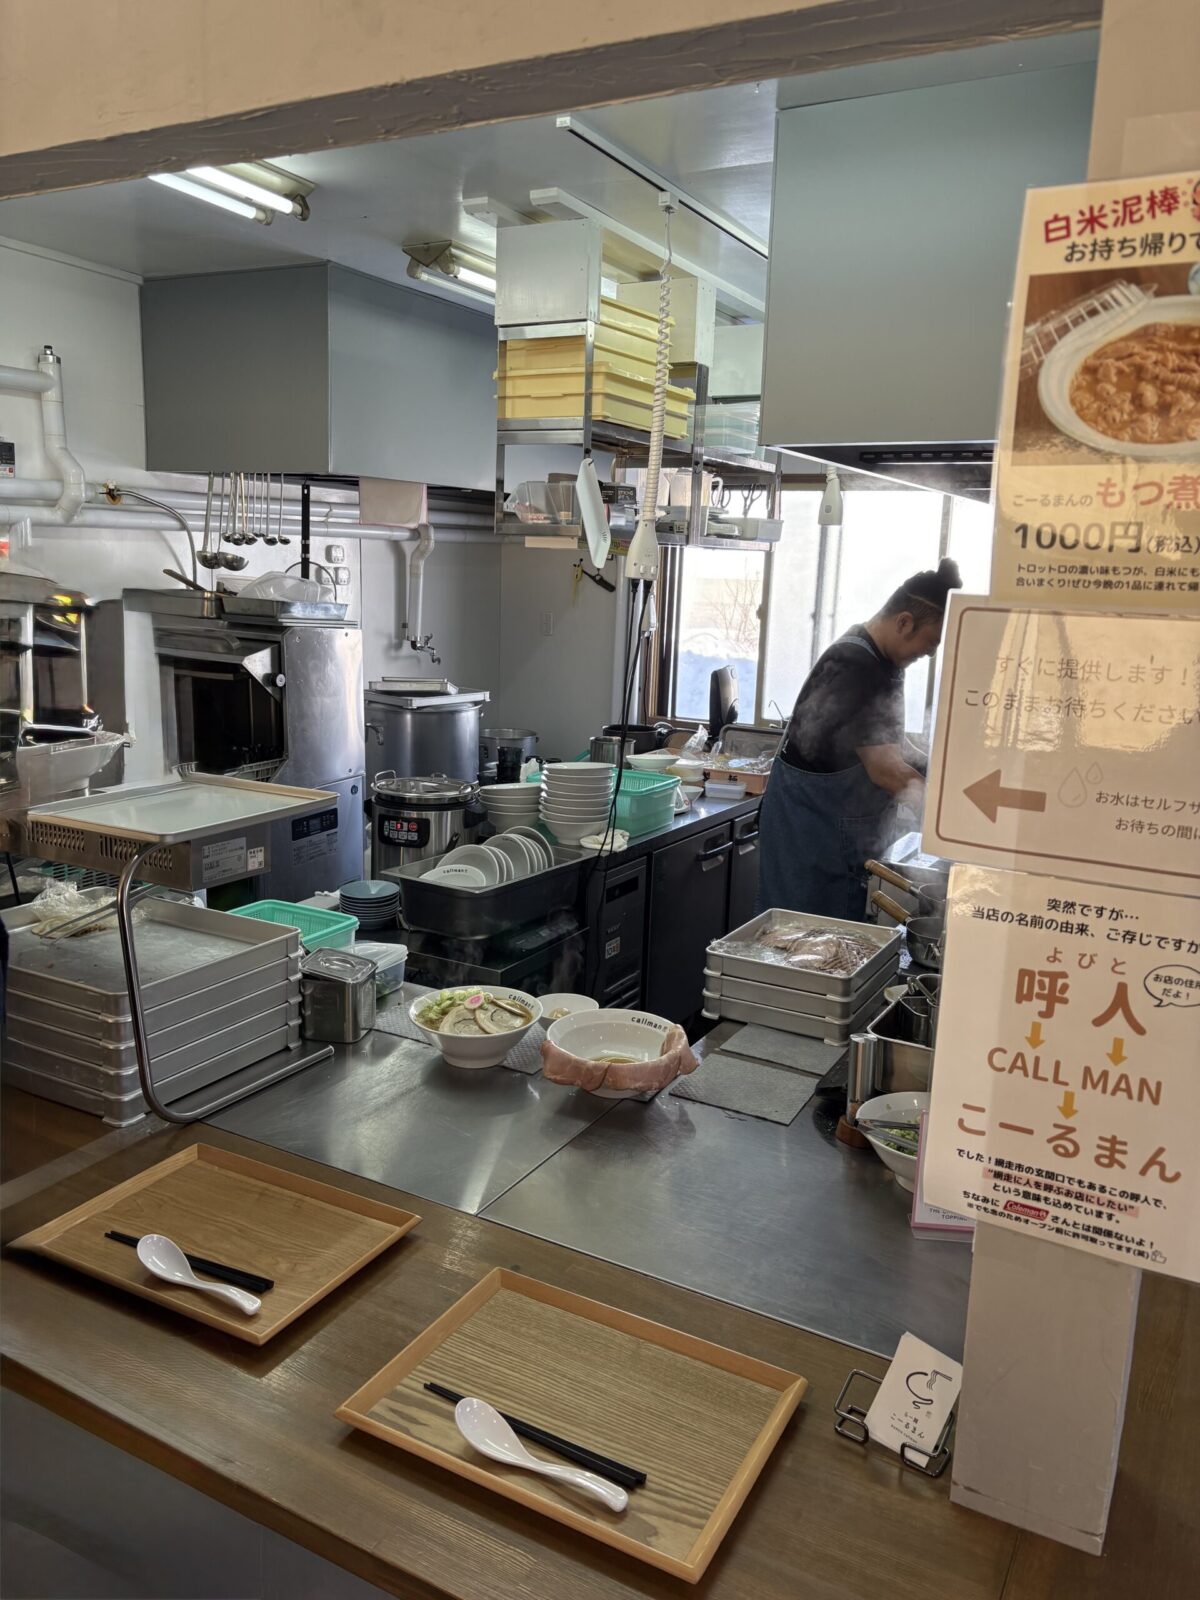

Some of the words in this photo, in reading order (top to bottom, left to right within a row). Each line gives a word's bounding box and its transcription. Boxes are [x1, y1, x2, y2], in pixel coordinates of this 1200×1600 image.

[1044, 186, 1180, 243] 白米泥棒
[996, 655, 1188, 686] すぐに提供します！
[987, 1047, 1070, 1087] CALL
[1081, 1065, 1163, 1106] MAN
[957, 1103, 1182, 1183] こーるまん
